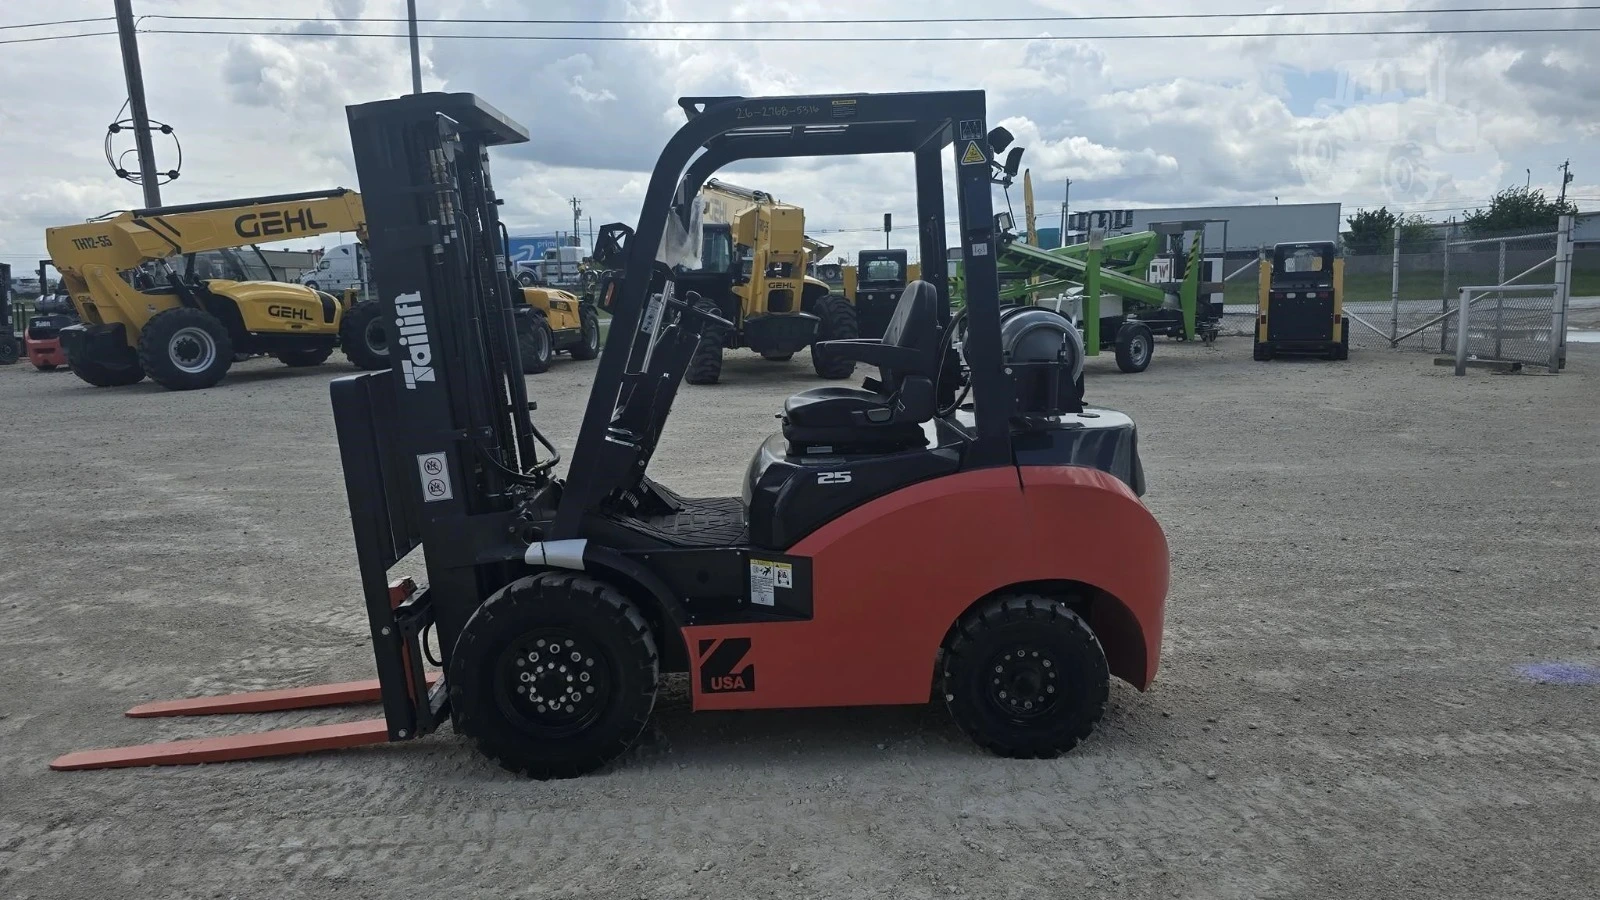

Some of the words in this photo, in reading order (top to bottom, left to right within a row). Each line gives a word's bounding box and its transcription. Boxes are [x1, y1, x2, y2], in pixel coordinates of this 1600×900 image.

[234, 207, 328, 238] GEHL
[72, 235, 113, 251] TH12-55
[537, 240, 558, 249] prim
[768, 281, 796, 289] GEHL
[268, 305, 314, 321] GEHL
[394, 290, 436, 390] Tailift
[817, 471, 852, 485] 25
[711, 676, 746, 690] USA
